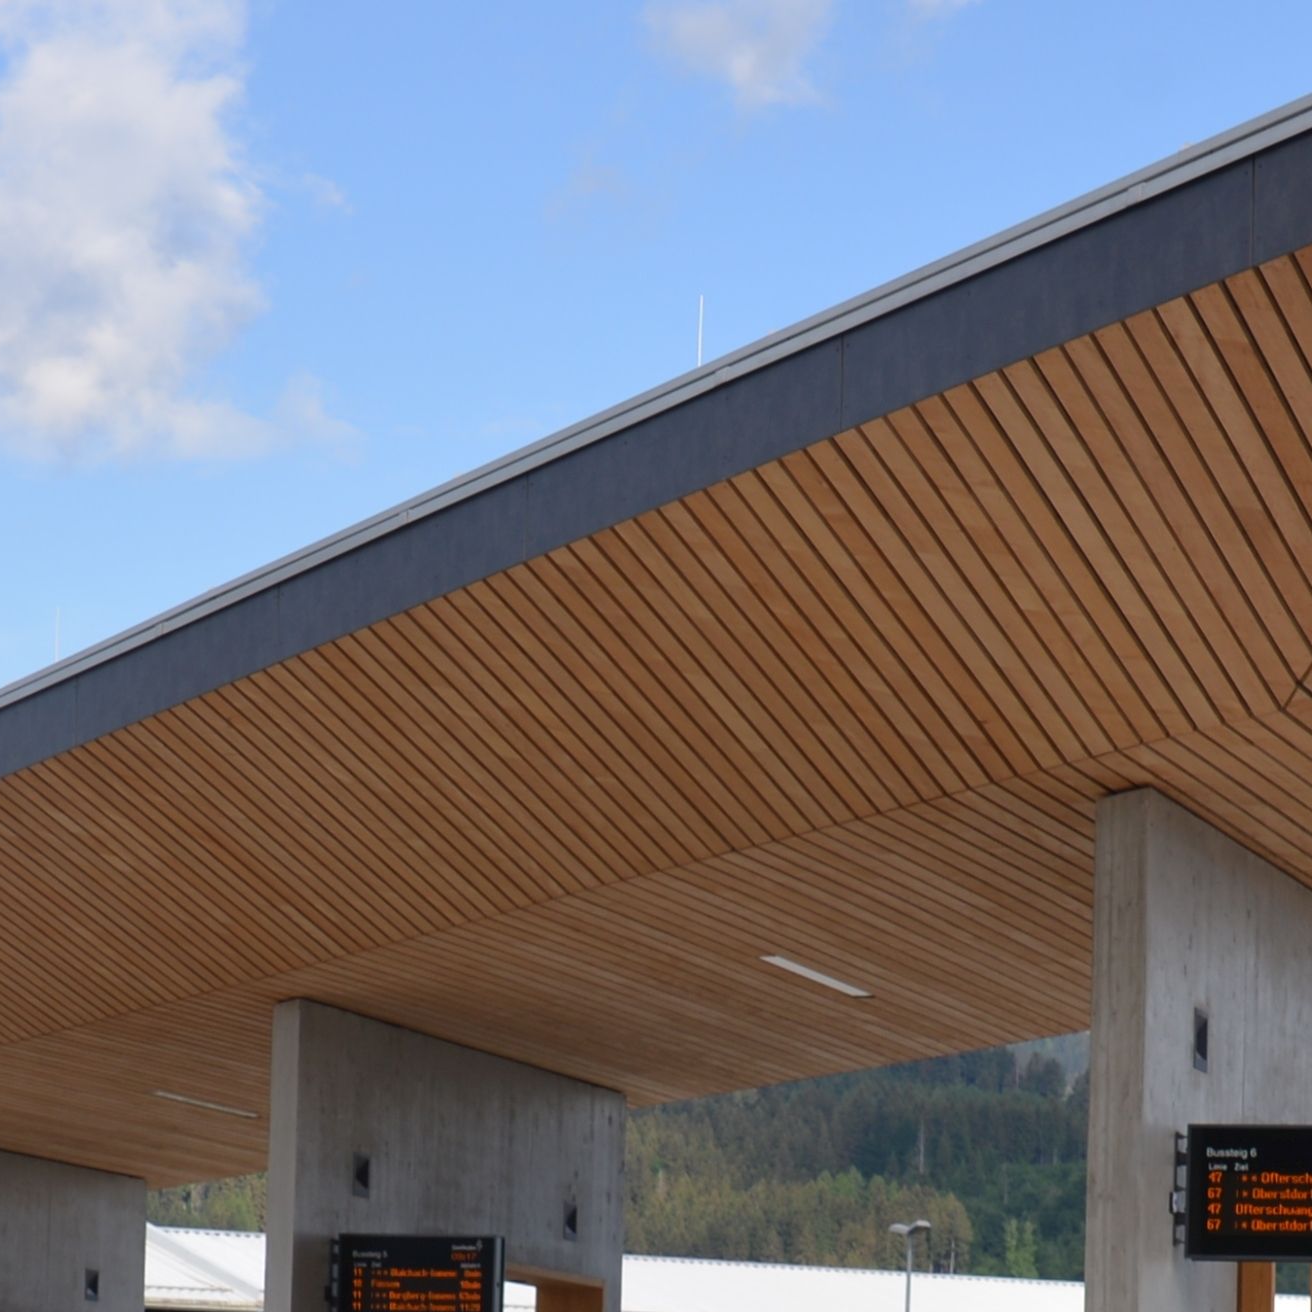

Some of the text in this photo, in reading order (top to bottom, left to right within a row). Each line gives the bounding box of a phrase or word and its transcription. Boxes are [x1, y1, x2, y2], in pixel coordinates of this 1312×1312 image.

[1206, 1148, 1257, 1160] Bussteig 6
[1208, 1173, 1222, 1184] 47
[1207, 1188, 1222, 1199] 67
[1207, 1203, 1222, 1215] 47
[1206, 1218, 1222, 1230] 67
